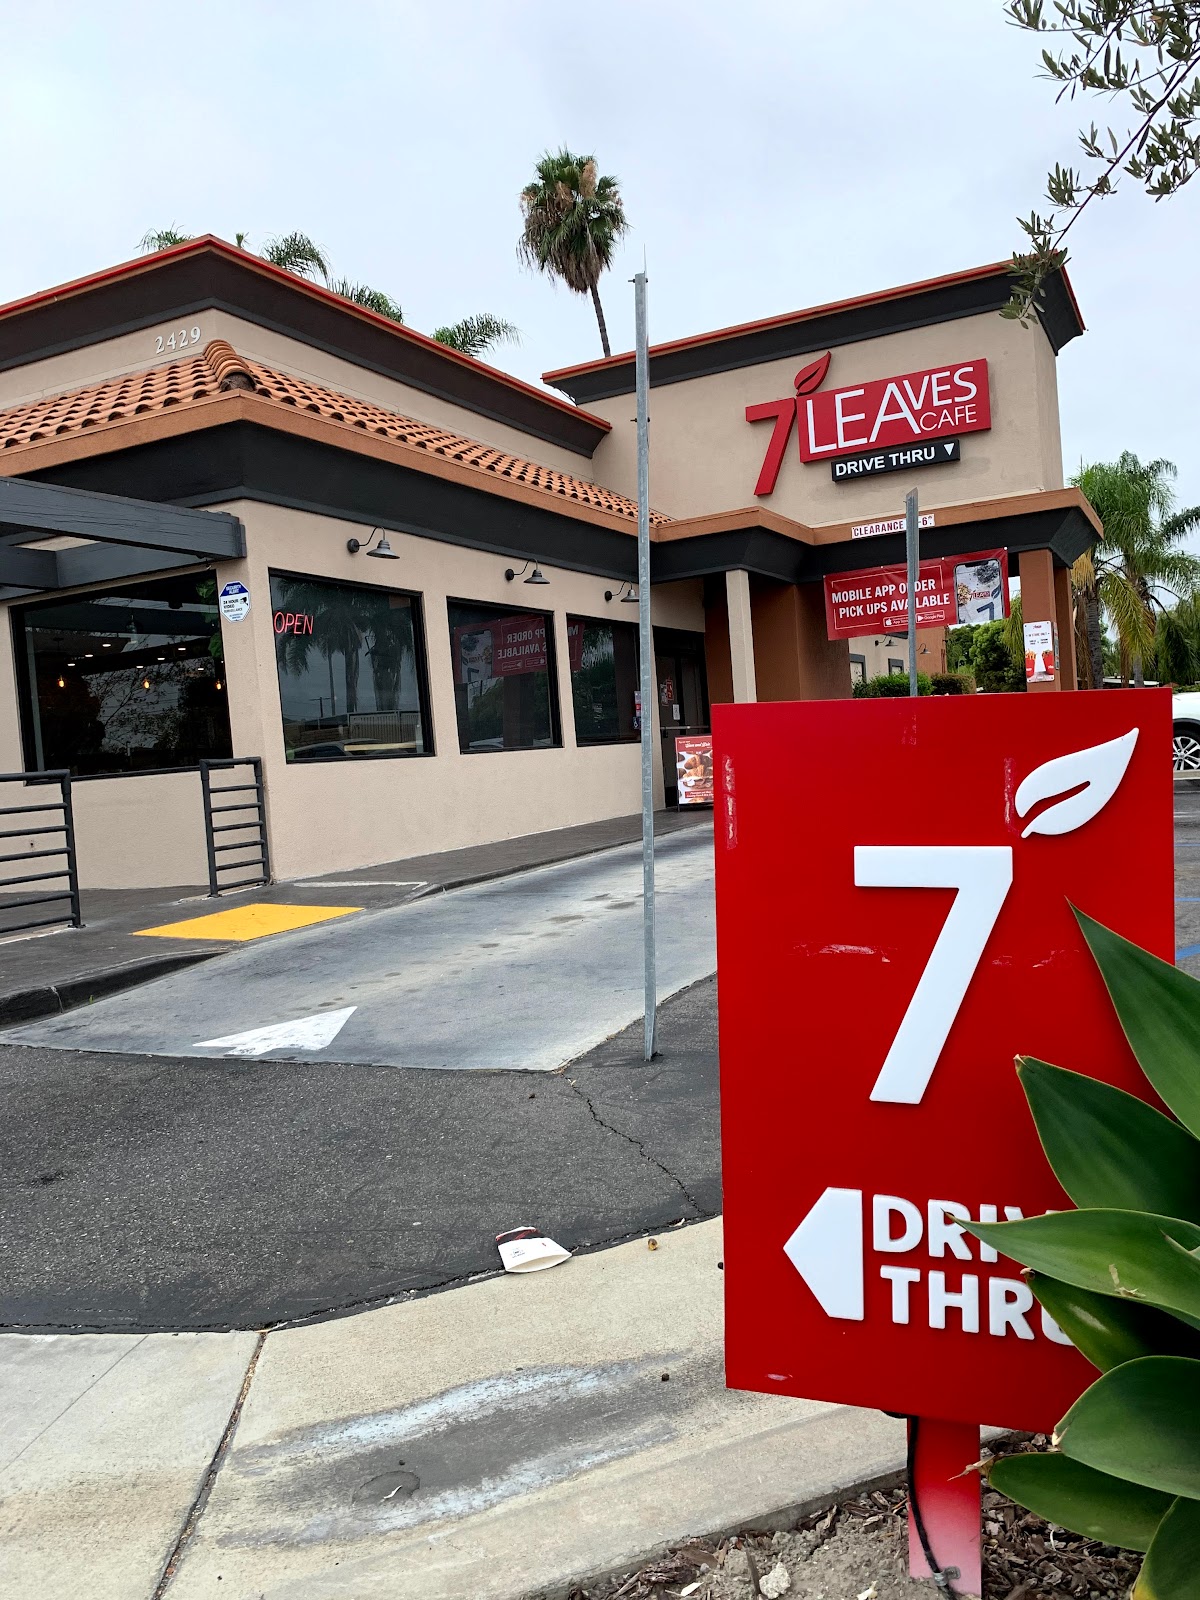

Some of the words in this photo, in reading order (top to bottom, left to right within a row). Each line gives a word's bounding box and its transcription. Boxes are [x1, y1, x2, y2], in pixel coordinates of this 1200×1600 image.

[154, 326, 201, 354] 2429
[745, 397, 797, 497] 7
[805, 366, 978, 454] LEAVES
[919, 403, 978, 432] CAFE
[835, 456, 885, 477] DRIVE
[888, 446, 936, 467] THRU
[853, 520, 904, 537] CLEARANCE
[831, 587, 873, 604] MOBILE
[874, 584, 896, 598] APP
[899, 578, 936, 594] ODER
[838, 605, 865, 619] PICK
[866, 601, 888, 615] UPS
[890, 593, 950, 612] AVALABLE
[273, 611, 314, 635] OPEN
[854, 845, 1013, 1104] 7
[873, 1193, 1058, 1264] DRI
